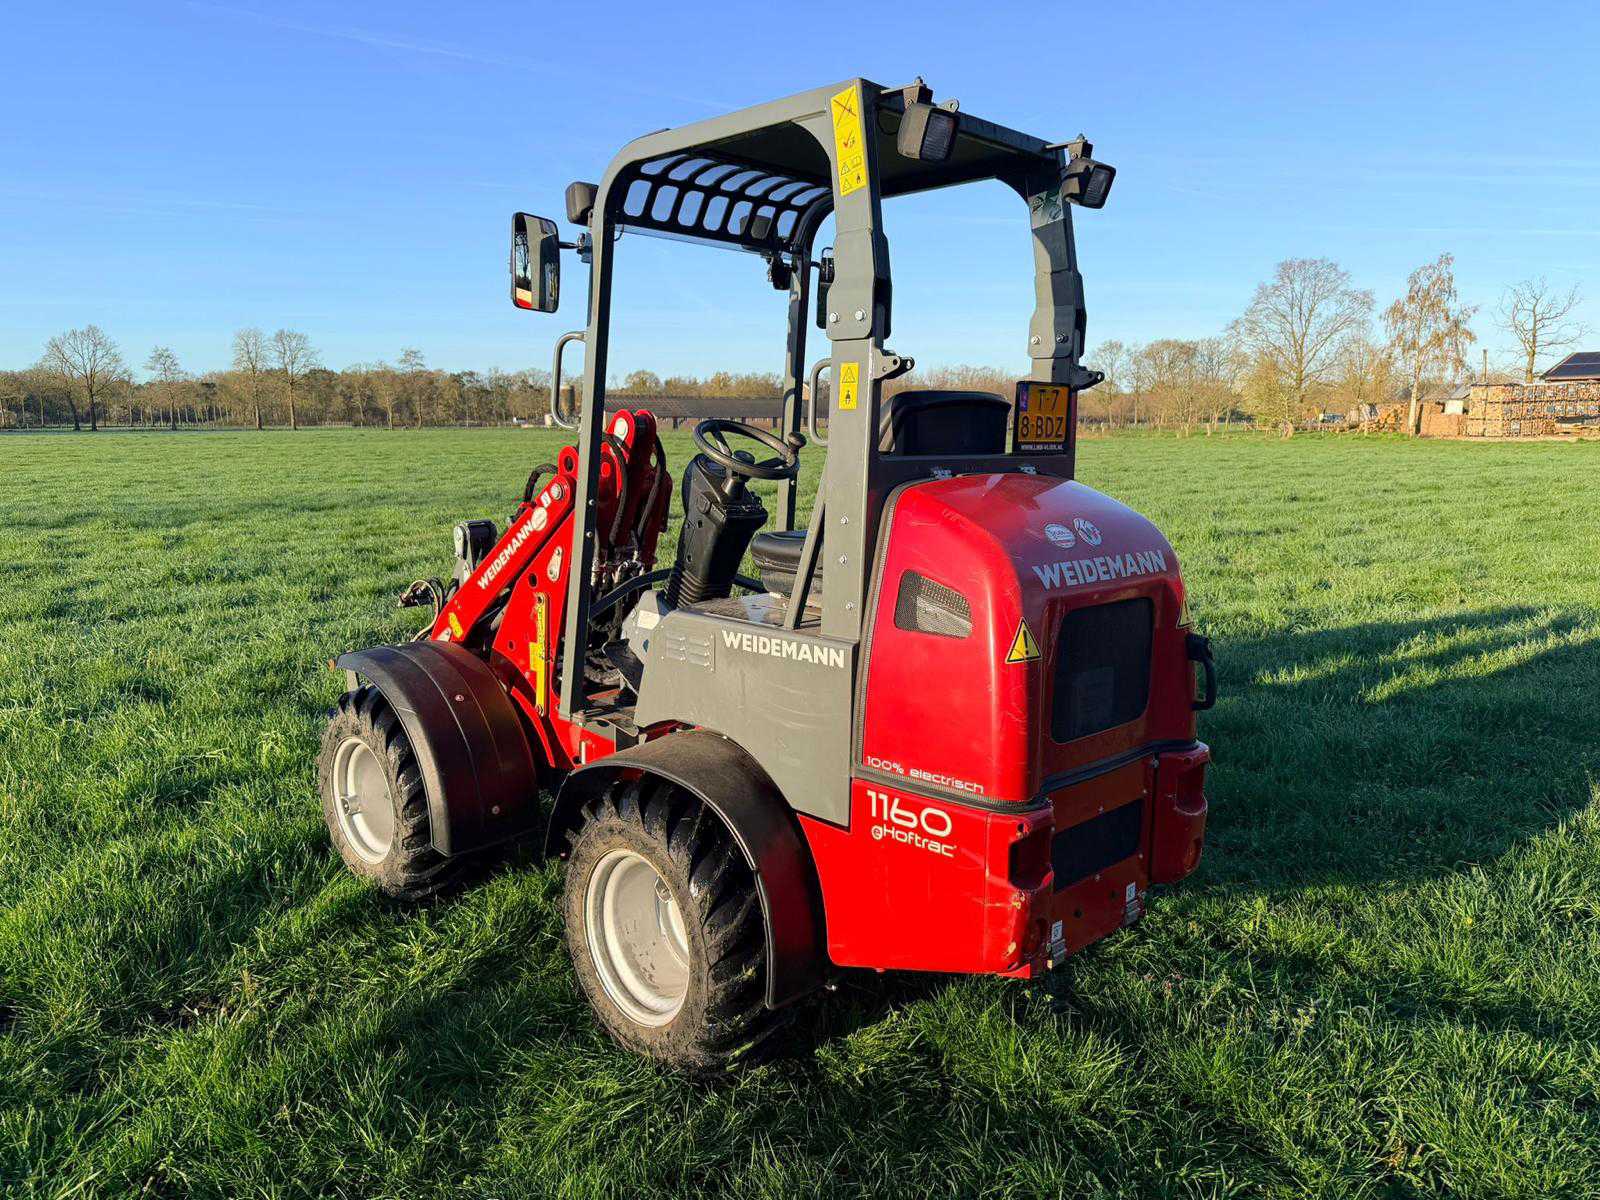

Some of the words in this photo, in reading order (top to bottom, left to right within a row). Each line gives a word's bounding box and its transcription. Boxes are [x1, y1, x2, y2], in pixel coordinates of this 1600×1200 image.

[477, 519, 535, 590] WEIDEMANN
[1032, 550, 1167, 591] WEIDEMANN
[722, 629, 845, 669] WEIDEMANN
[867, 755, 904, 775] 100%
[910, 767, 984, 794] electrisch
[867, 789, 952, 838] 1160
